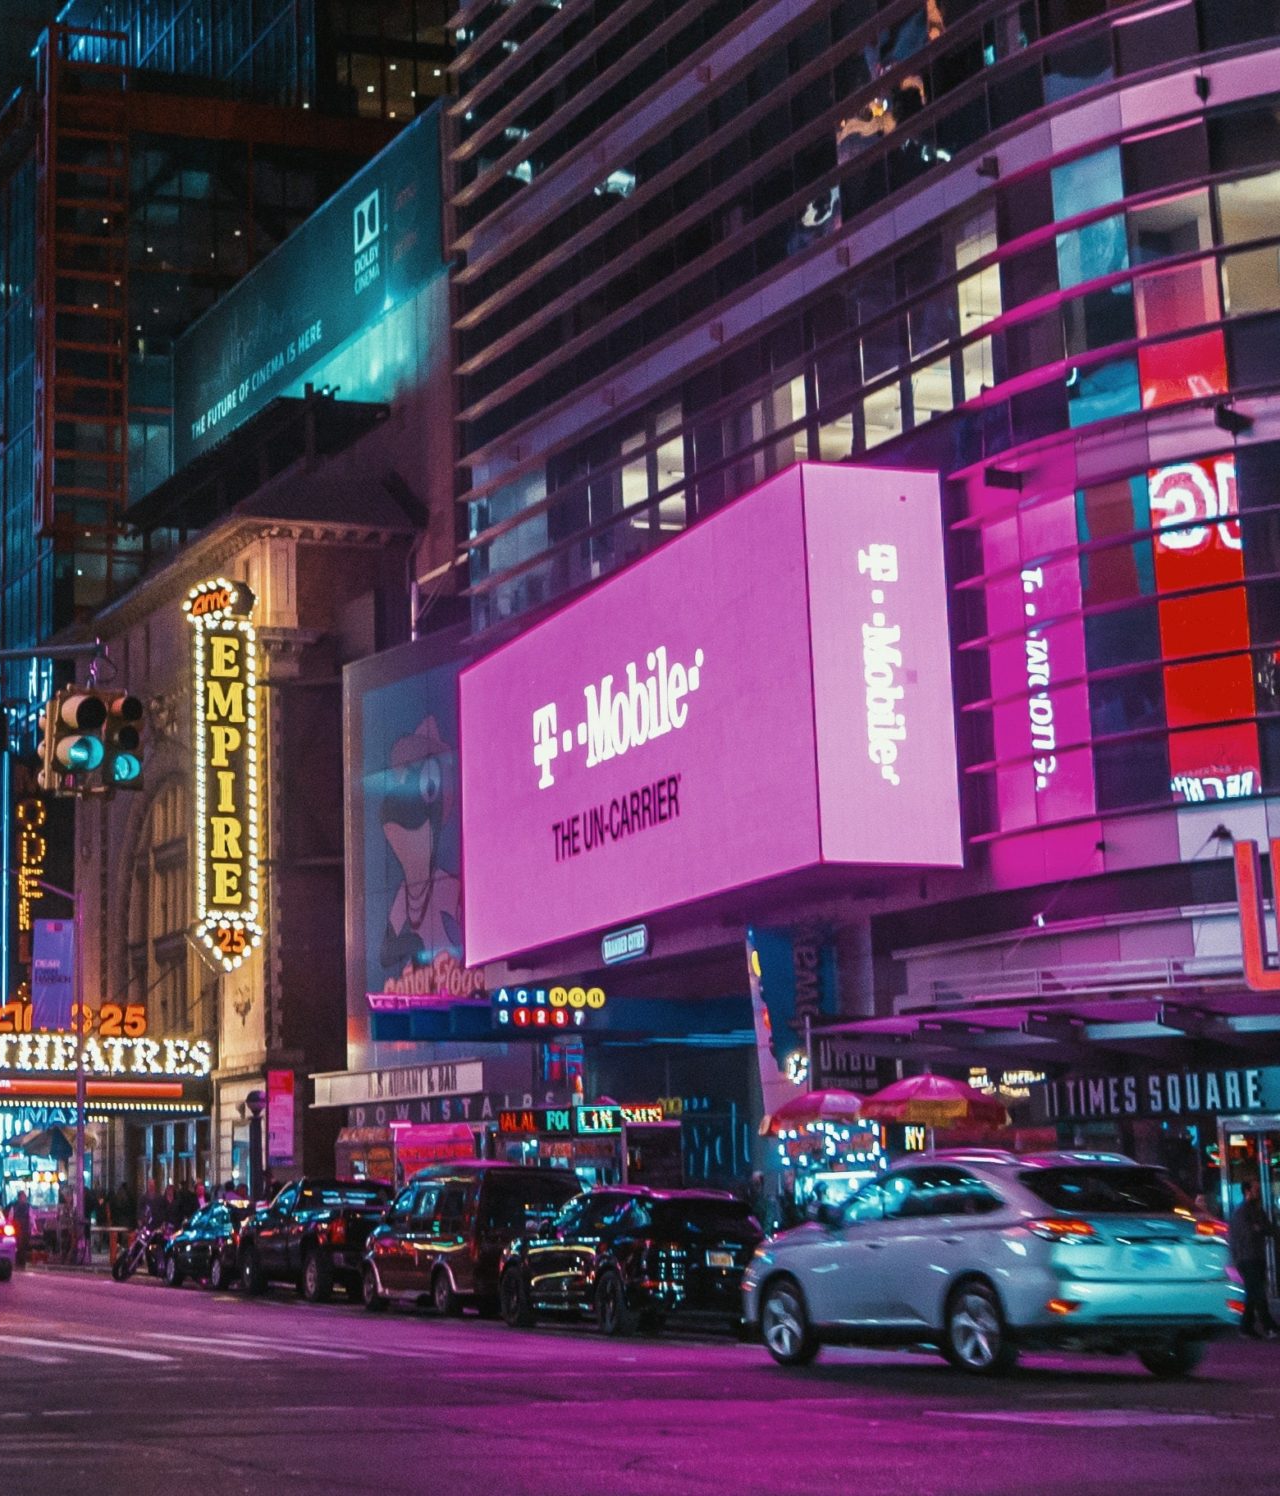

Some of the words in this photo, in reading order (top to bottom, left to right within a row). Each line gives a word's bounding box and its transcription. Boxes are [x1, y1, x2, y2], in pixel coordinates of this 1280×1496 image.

[354, 241, 379, 276] DOLBY
[191, 414, 206, 440] THE
[207, 389, 237, 429] FUTURE
[238, 379, 250, 402] OF
[251, 352, 285, 391] CINEMA
[287, 342, 296, 364] IS
[298, 319, 322, 355] HERE
[205, 636, 246, 905] EMPIRE
[552, 819, 581, 863] THE
[217, 928, 247, 954] 25
[99, 1003, 148, 1038] 25
[438, 1064, 457, 1092] BAR
[1067, 1075, 1137, 1117] TIMES
[1148, 1069, 1263, 1114] SQUARE
[905, 1126, 925, 1150] NY
